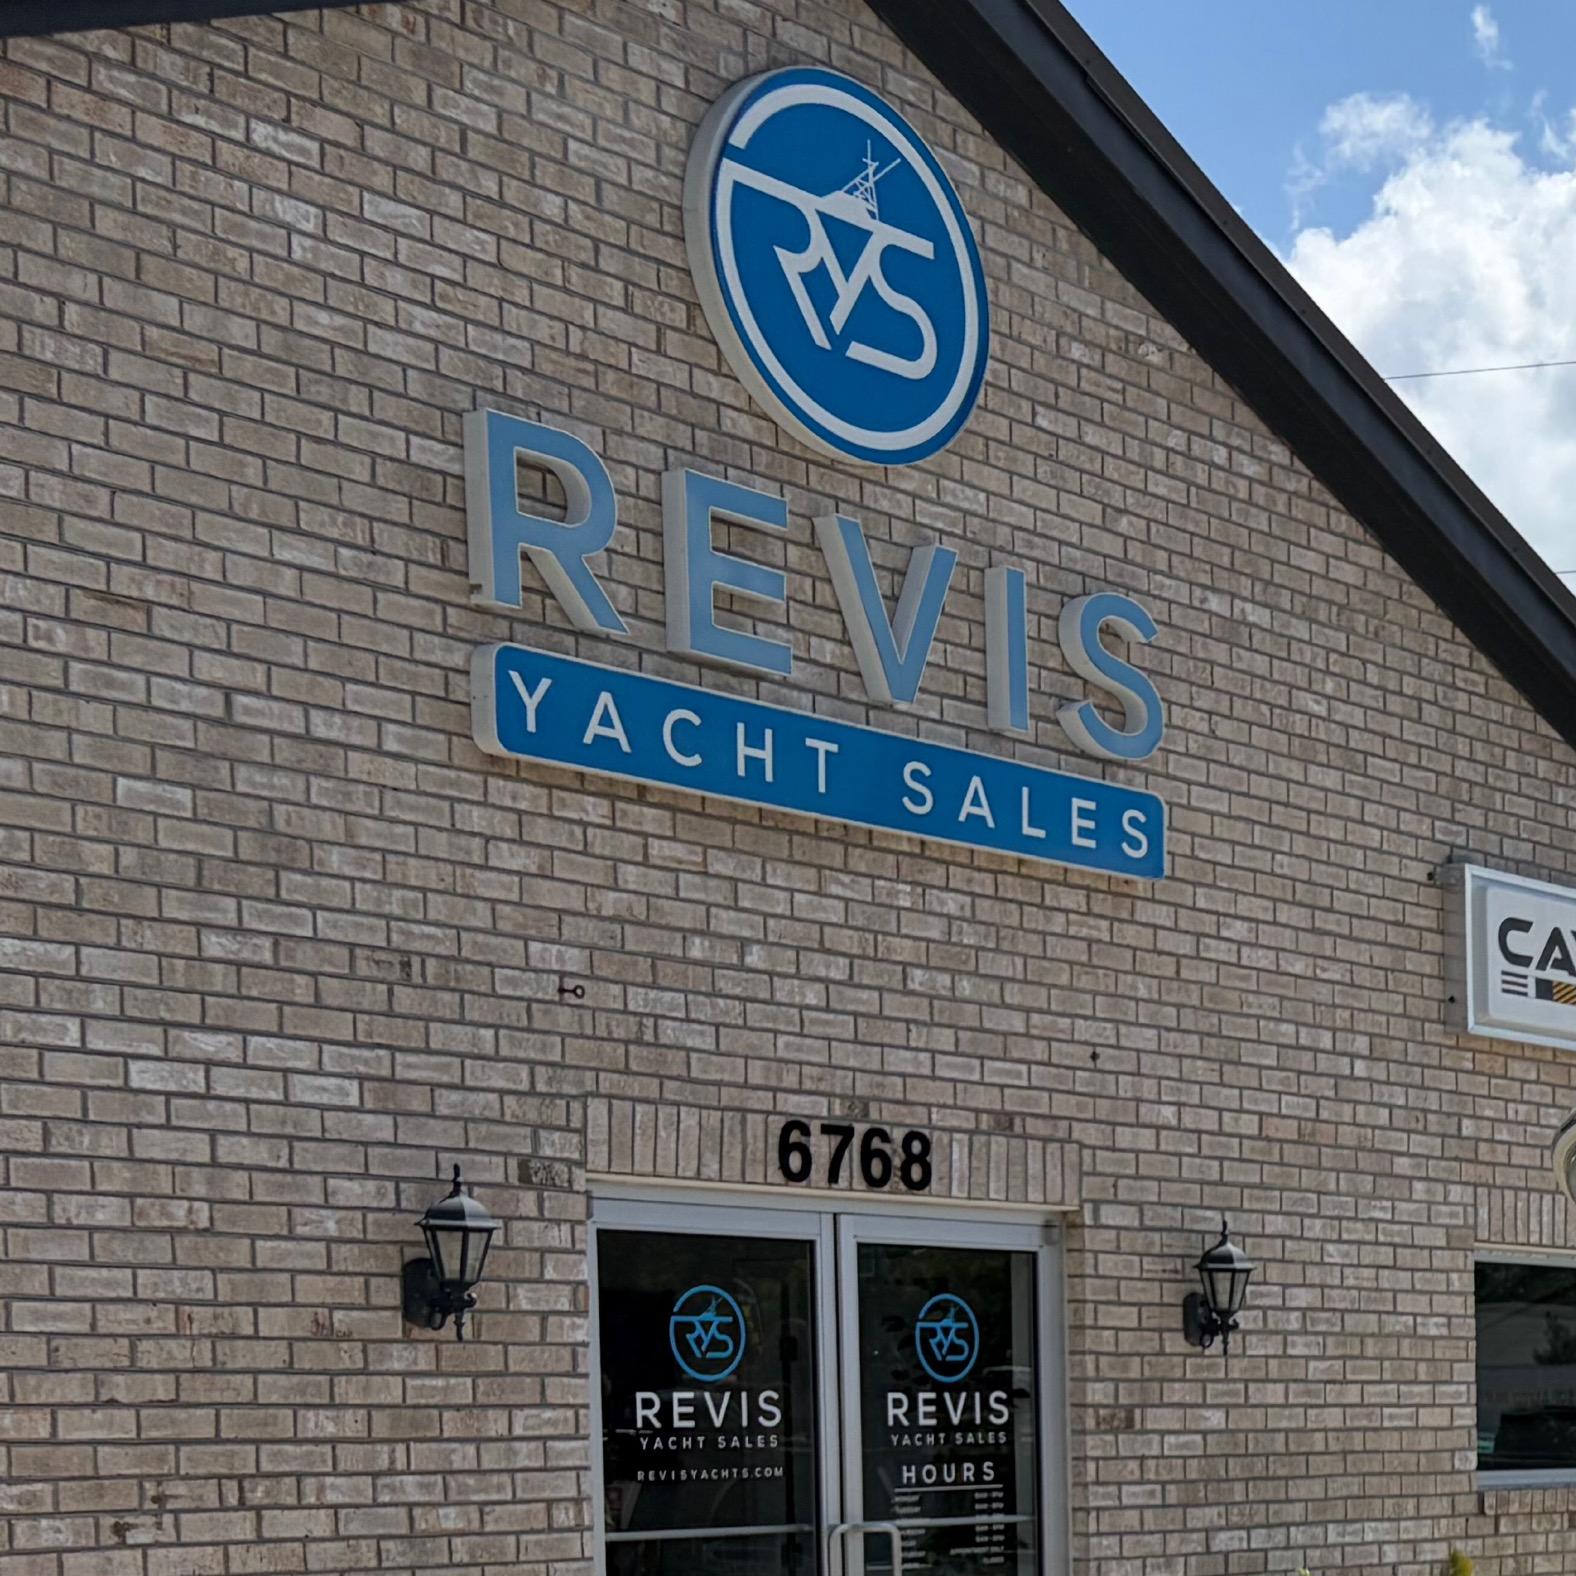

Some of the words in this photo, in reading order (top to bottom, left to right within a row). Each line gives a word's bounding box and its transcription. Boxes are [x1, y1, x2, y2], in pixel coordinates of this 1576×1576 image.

[465, 408, 1165, 761] REVIS
[508, 669, 840, 796] YACHT
[901, 760, 1150, 860] SALES
[778, 1119, 933, 1191] 6768
[635, 1390, 782, 1429] REVIS
[887, 1390, 1010, 1427] REVIS
[640, 1436, 705, 1450] YACHT
[718, 1434, 779, 1449] SALES
[890, 1433, 946, 1446] YACHT
[955, 1431, 1007, 1445] SALES
[637, 1466, 784, 1481] REVISYACHTS.COM
[902, 1461, 995, 1484] HOURS
